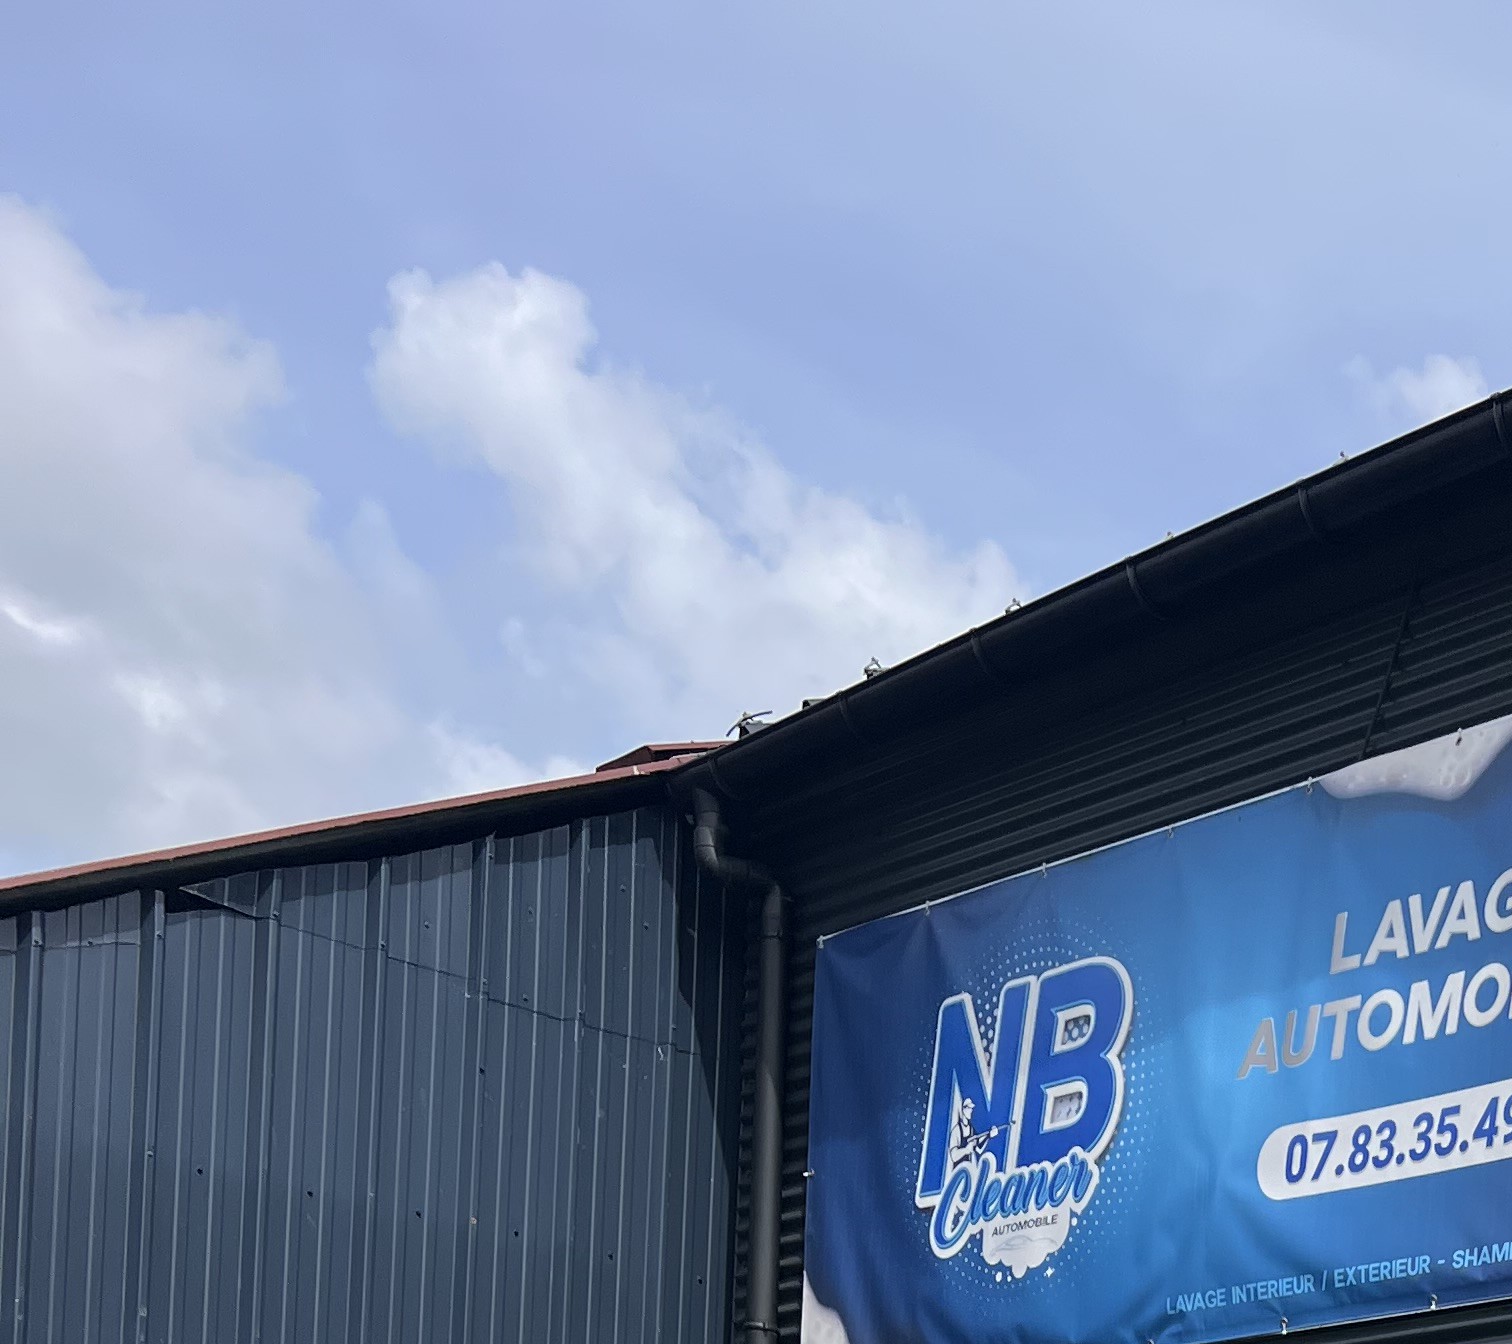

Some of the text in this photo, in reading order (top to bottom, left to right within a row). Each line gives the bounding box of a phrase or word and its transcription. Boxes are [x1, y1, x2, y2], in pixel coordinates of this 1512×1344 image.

[916, 957, 1132, 1207] NB
[932, 1150, 1093, 1250] Cleaner
[991, 1214, 1059, 1238] AUTOMOBILE
[1166, 1287, 1227, 1316] LAVAGE
[1231, 1273, 1316, 1305] INTERIEUR
[1333, 1254, 1432, 1289] EXTERIEUR
